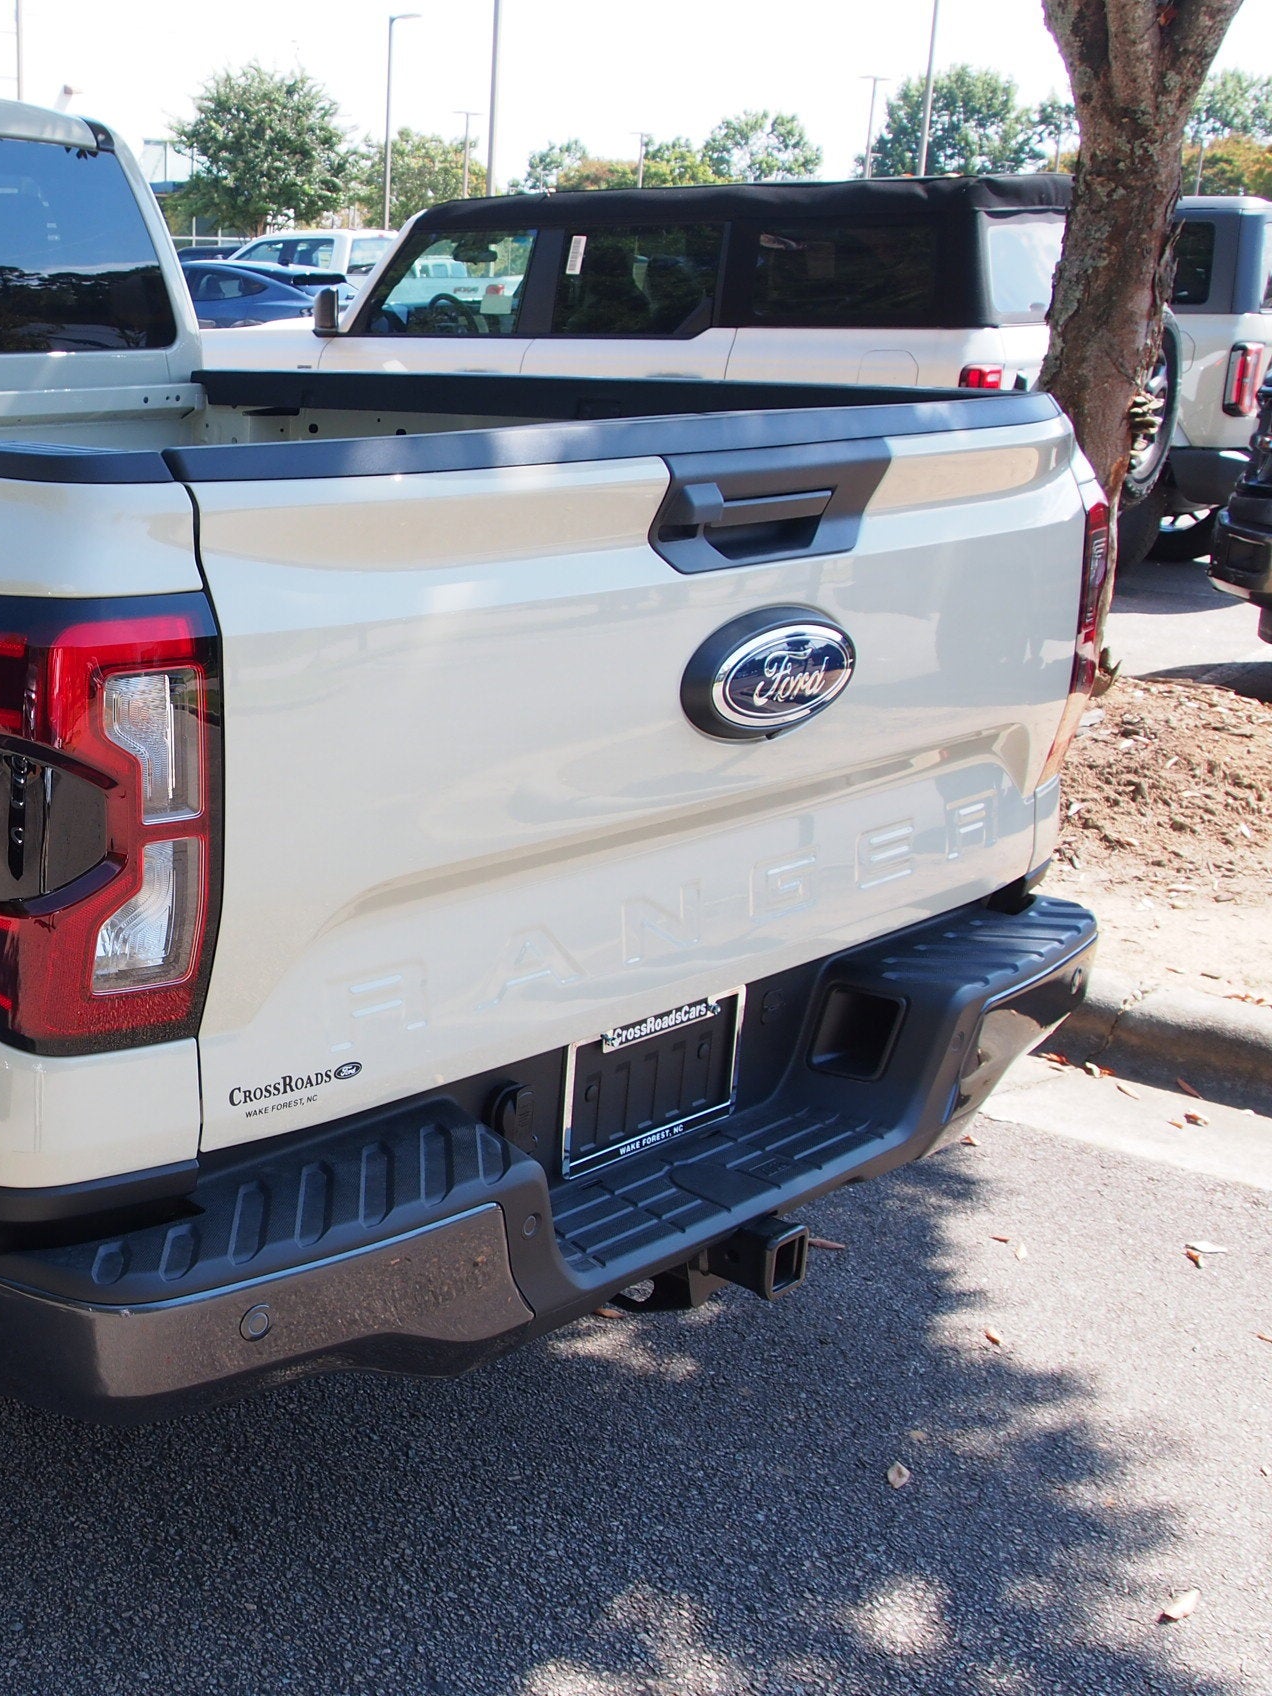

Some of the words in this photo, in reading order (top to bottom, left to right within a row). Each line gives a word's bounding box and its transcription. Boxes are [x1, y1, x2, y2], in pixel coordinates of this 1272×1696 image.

[753, 646, 830, 706] Ford
[326, 789, 998, 1053] RANGER
[613, 1002, 707, 1046] CrossRoadsCars
[245, 1107, 269, 1118] WAKE
[271, 1098, 305, 1113] FOREST,
[306, 1094, 318, 1103] NC
[619, 1141, 641, 1155] WAKE
[642, 1129, 672, 1147] FOREST,
[673, 1124, 684, 1135] NC
